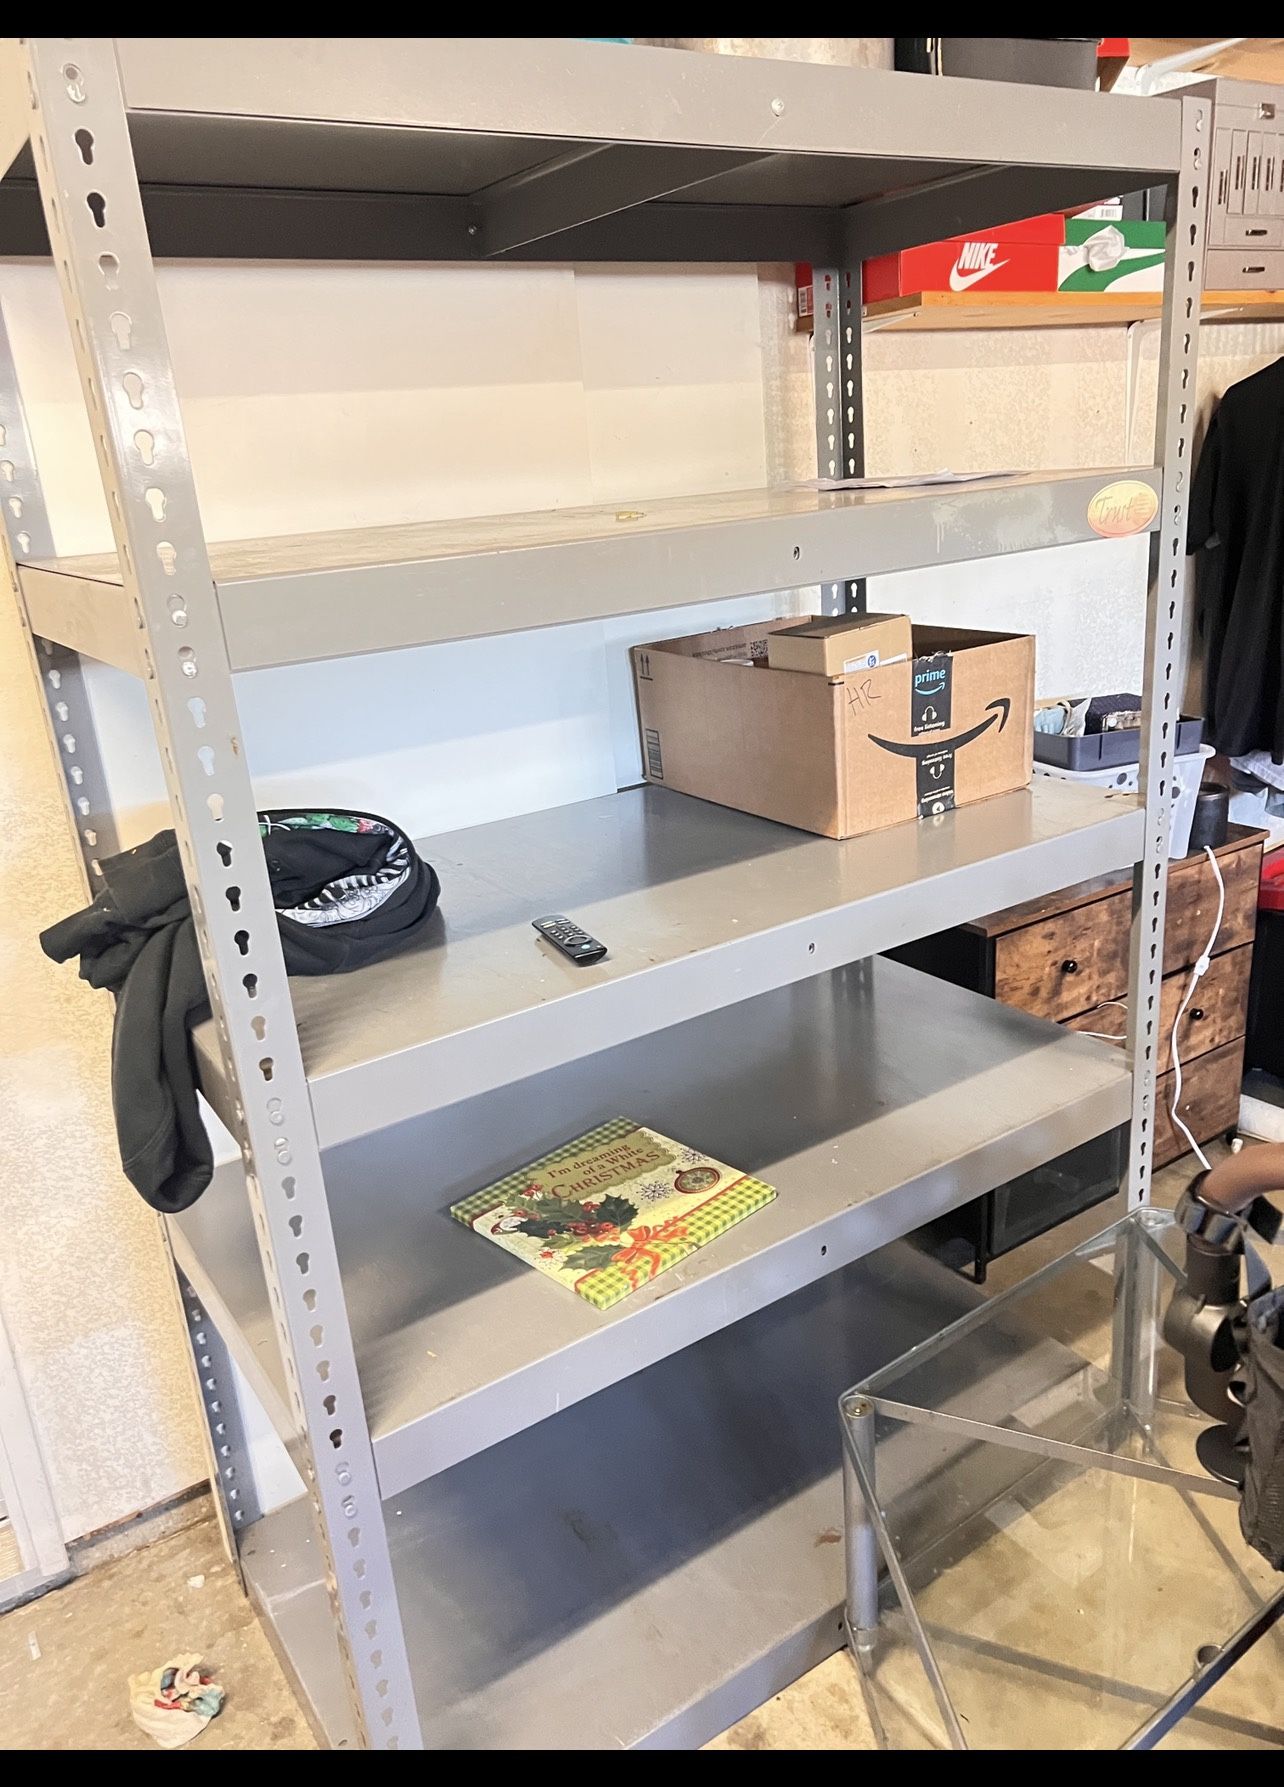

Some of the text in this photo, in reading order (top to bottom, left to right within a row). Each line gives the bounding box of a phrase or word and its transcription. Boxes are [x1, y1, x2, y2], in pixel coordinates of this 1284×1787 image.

[958, 242, 999, 269] NIKE
[915, 669, 946, 687] prime
[846, 679, 882, 716] HR
[547, 1144, 632, 1179] I'm dreaming
[551, 1150, 660, 1199] CHRISTMAS
[583, 1166, 594, 1176] of
[605, 1147, 644, 1165] White
